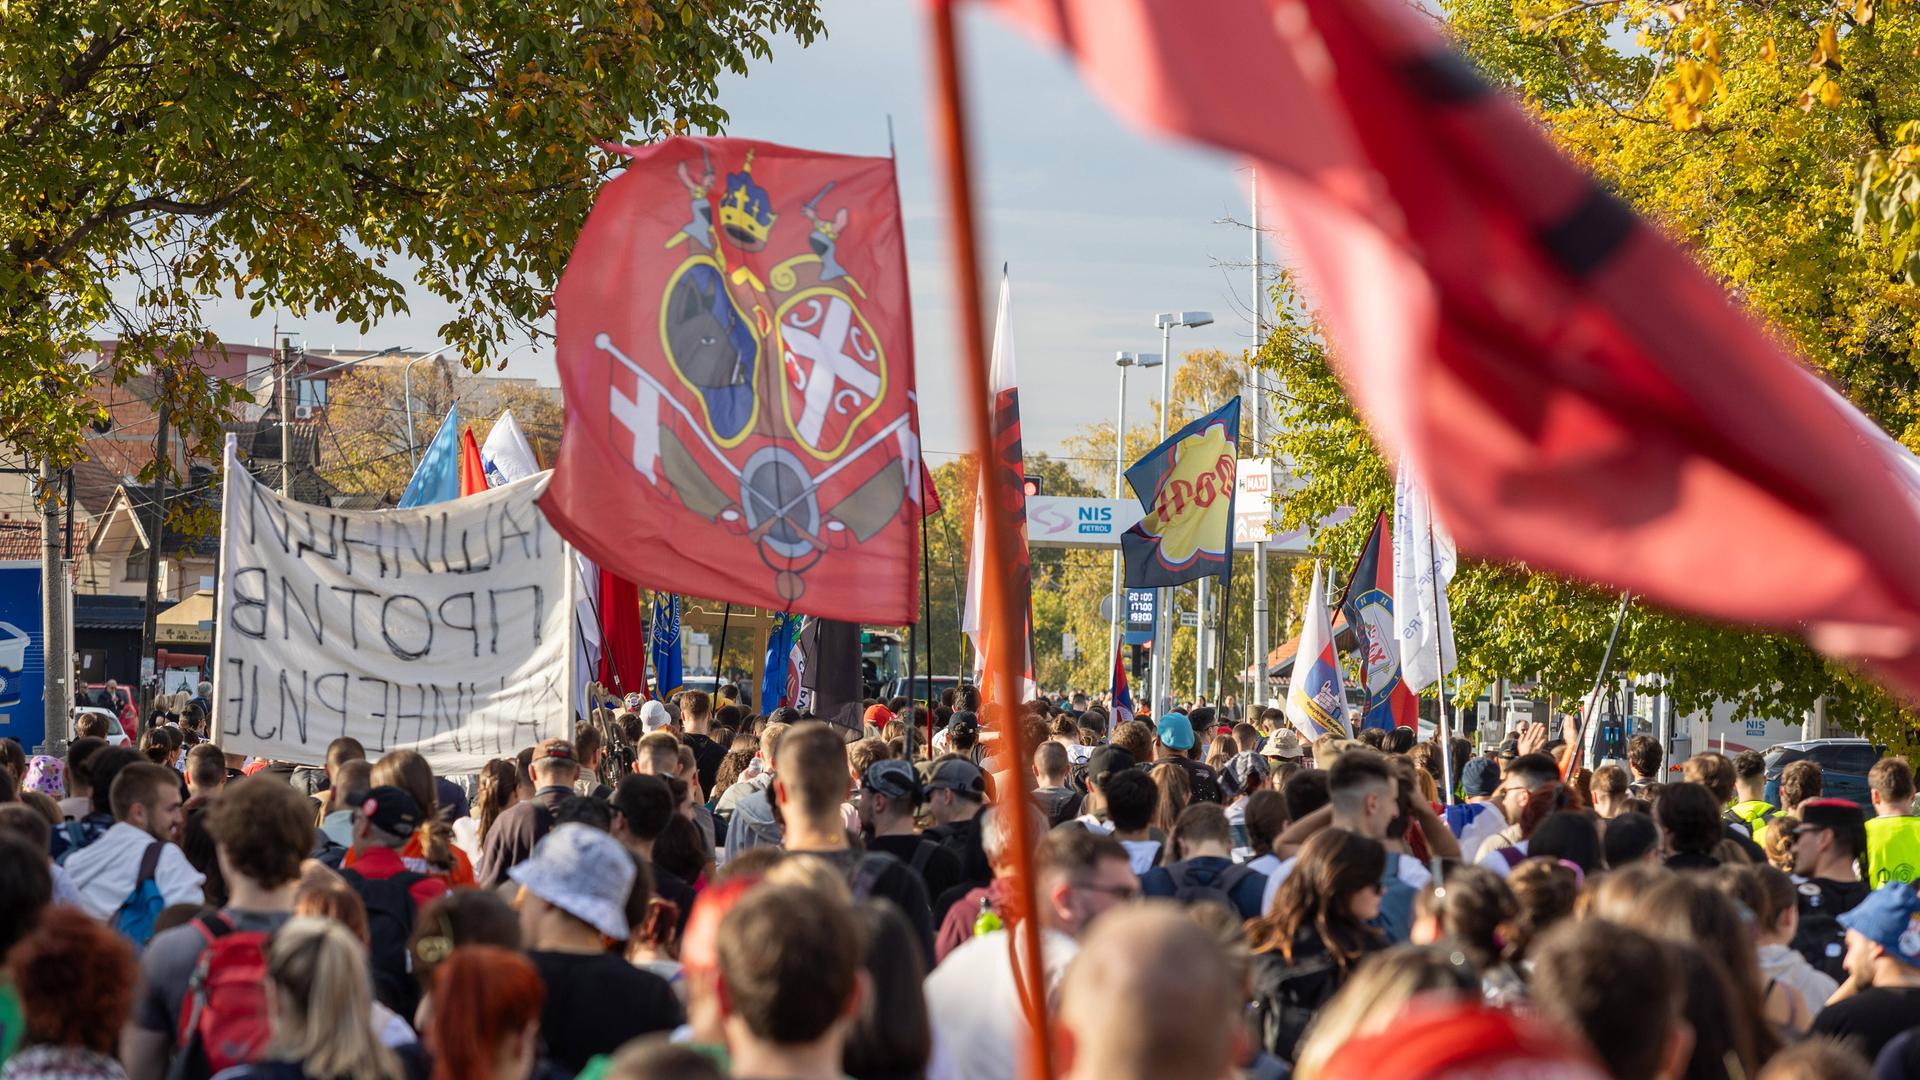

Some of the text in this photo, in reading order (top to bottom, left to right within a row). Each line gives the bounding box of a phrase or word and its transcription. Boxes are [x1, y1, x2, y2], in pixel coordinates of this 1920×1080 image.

[1078, 506, 1112, 521] NIS
[1081, 524, 1109, 532] PETROL
[1746, 720, 1765, 729] NIS
